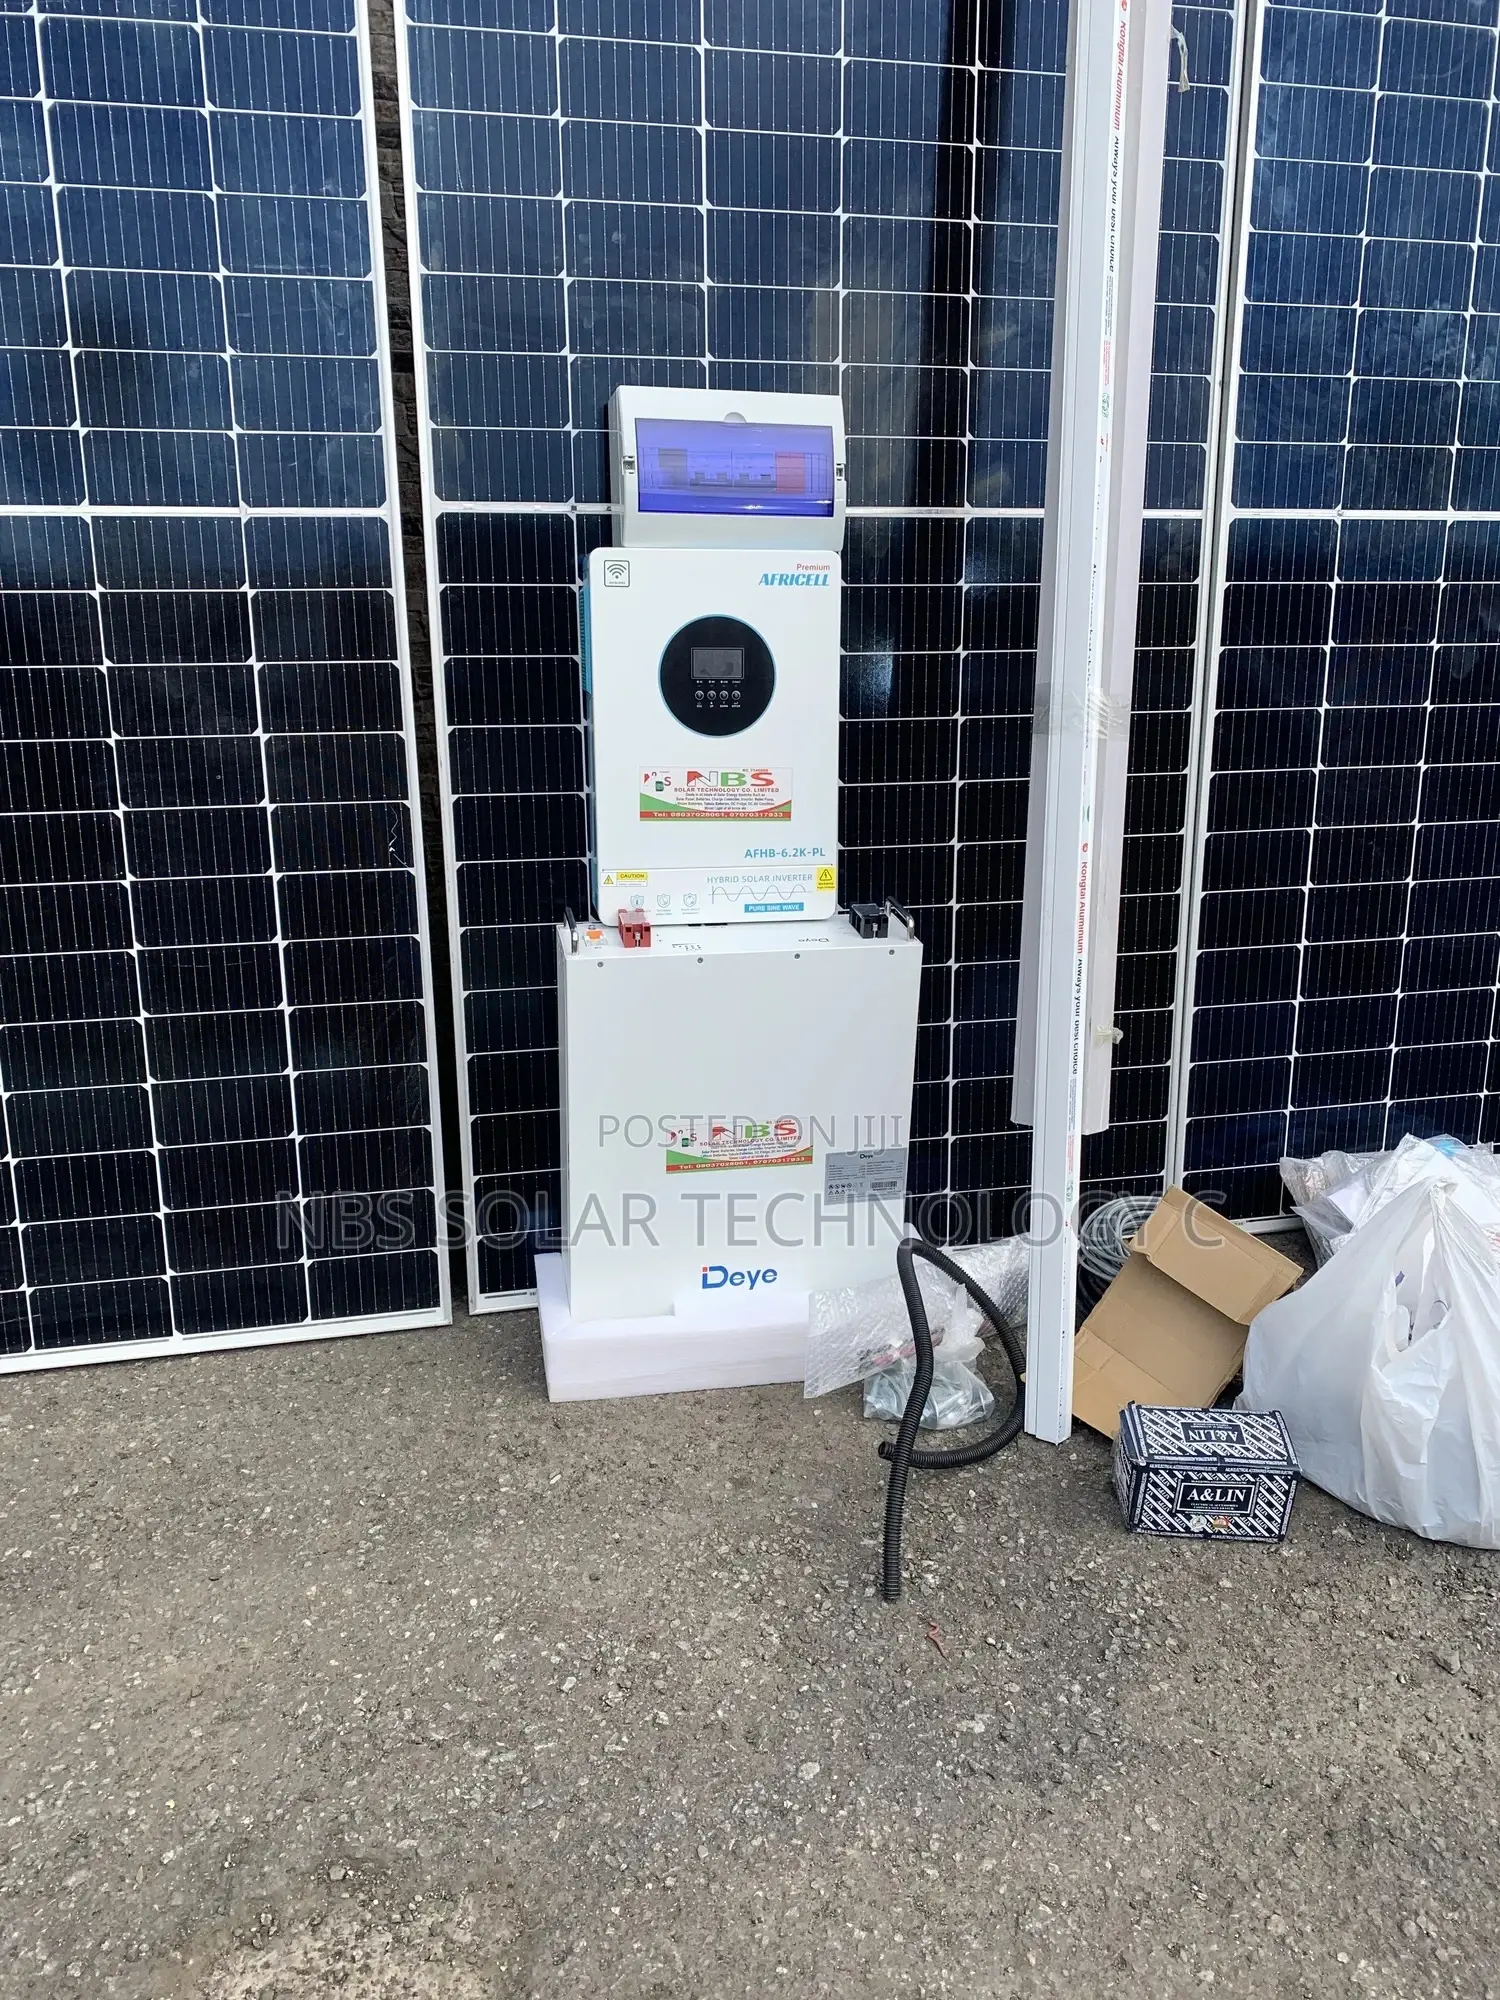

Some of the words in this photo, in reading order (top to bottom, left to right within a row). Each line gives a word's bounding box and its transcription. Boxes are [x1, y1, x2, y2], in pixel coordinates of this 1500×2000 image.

[758, 573, 830, 586] AFRICELL
[687, 771, 774, 786] NBS
[744, 848, 826, 858] AFHB-6.2K-PL
[772, 874, 812, 882] INVERTER
[712, 1122, 797, 1140] NBS
[702, 1266, 778, 1290] Deye
[1188, 1429, 1239, 1442] A&LIN
[1187, 1488, 1247, 1502] A&LIN
